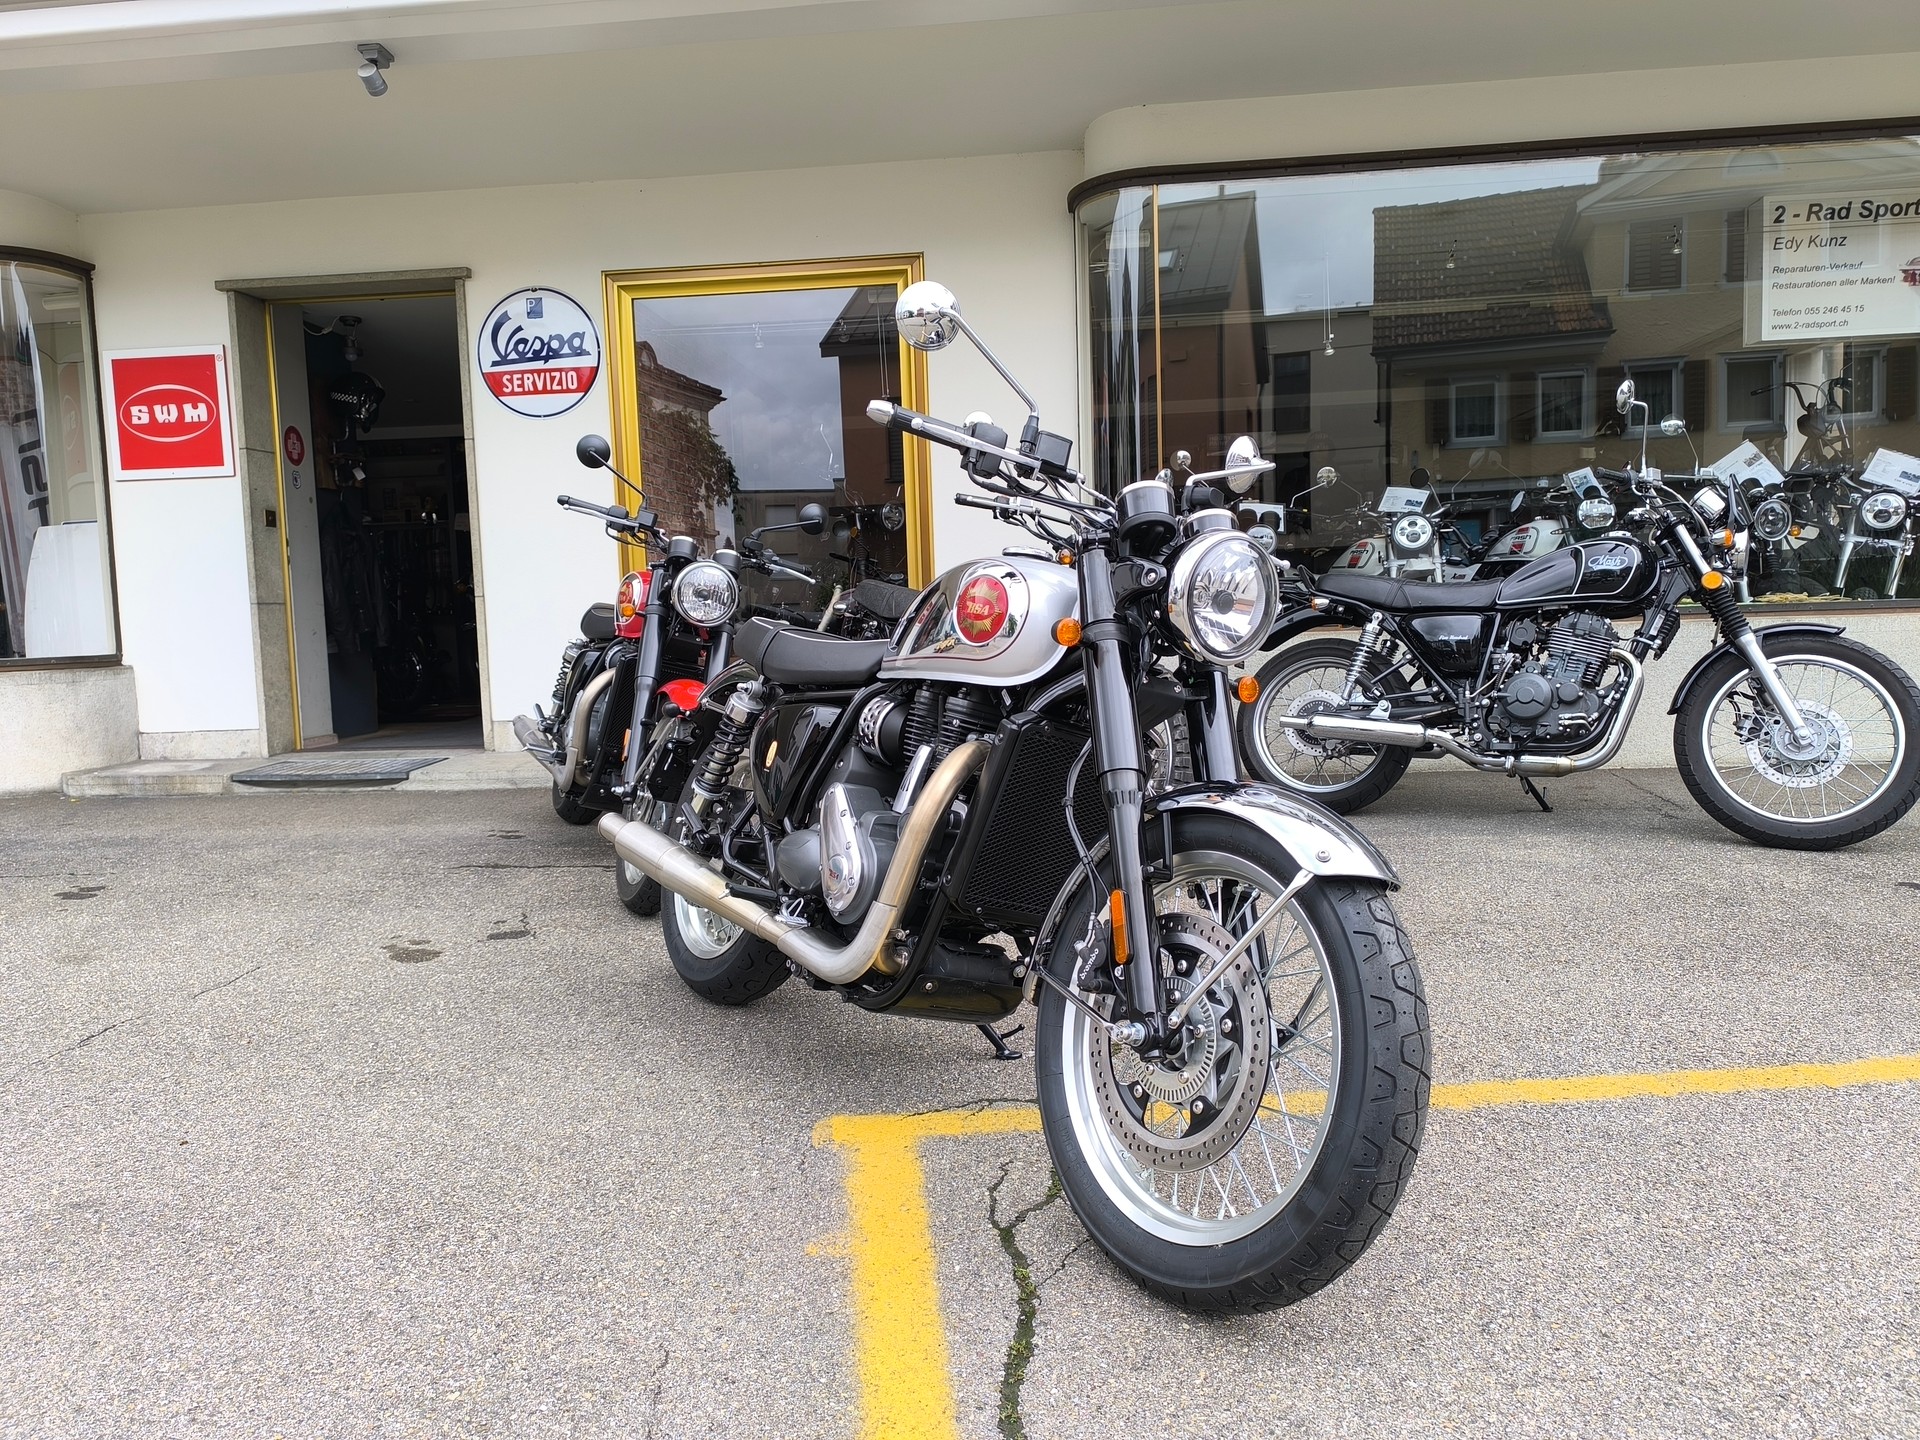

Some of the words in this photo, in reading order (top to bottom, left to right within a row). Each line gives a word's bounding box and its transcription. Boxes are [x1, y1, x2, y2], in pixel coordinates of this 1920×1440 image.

[1773, 205, 1786, 223] 2
[1806, 201, 1852, 222] Rad
[1858, 199, 1920, 222] Sport
[1773, 236, 1804, 252] Edy
[1807, 234, 1848, 248] Kunz
[1772, 261, 1863, 275] Reparaturen-Verkauf
[1771, 279, 1837, 290] Restaurationen
[1839, 278, 1858, 286] aller
[1860, 276, 1896, 286] Marken!
[1772, 308, 1802, 317] Telefon
[1804, 307, 1820, 315] 055
[1822, 306, 1839, 314] 246
[1840, 305, 1852, 313] 45
[1854, 304, 1865, 313] 15
[1771, 319, 1849, 331] www.2-radsport.ch
[490, 310, 592, 368] Vespa
[502, 370, 578, 393] SERVIZIO
[129, 402, 208, 425] SWM
[966, 601, 990, 615] BSA
